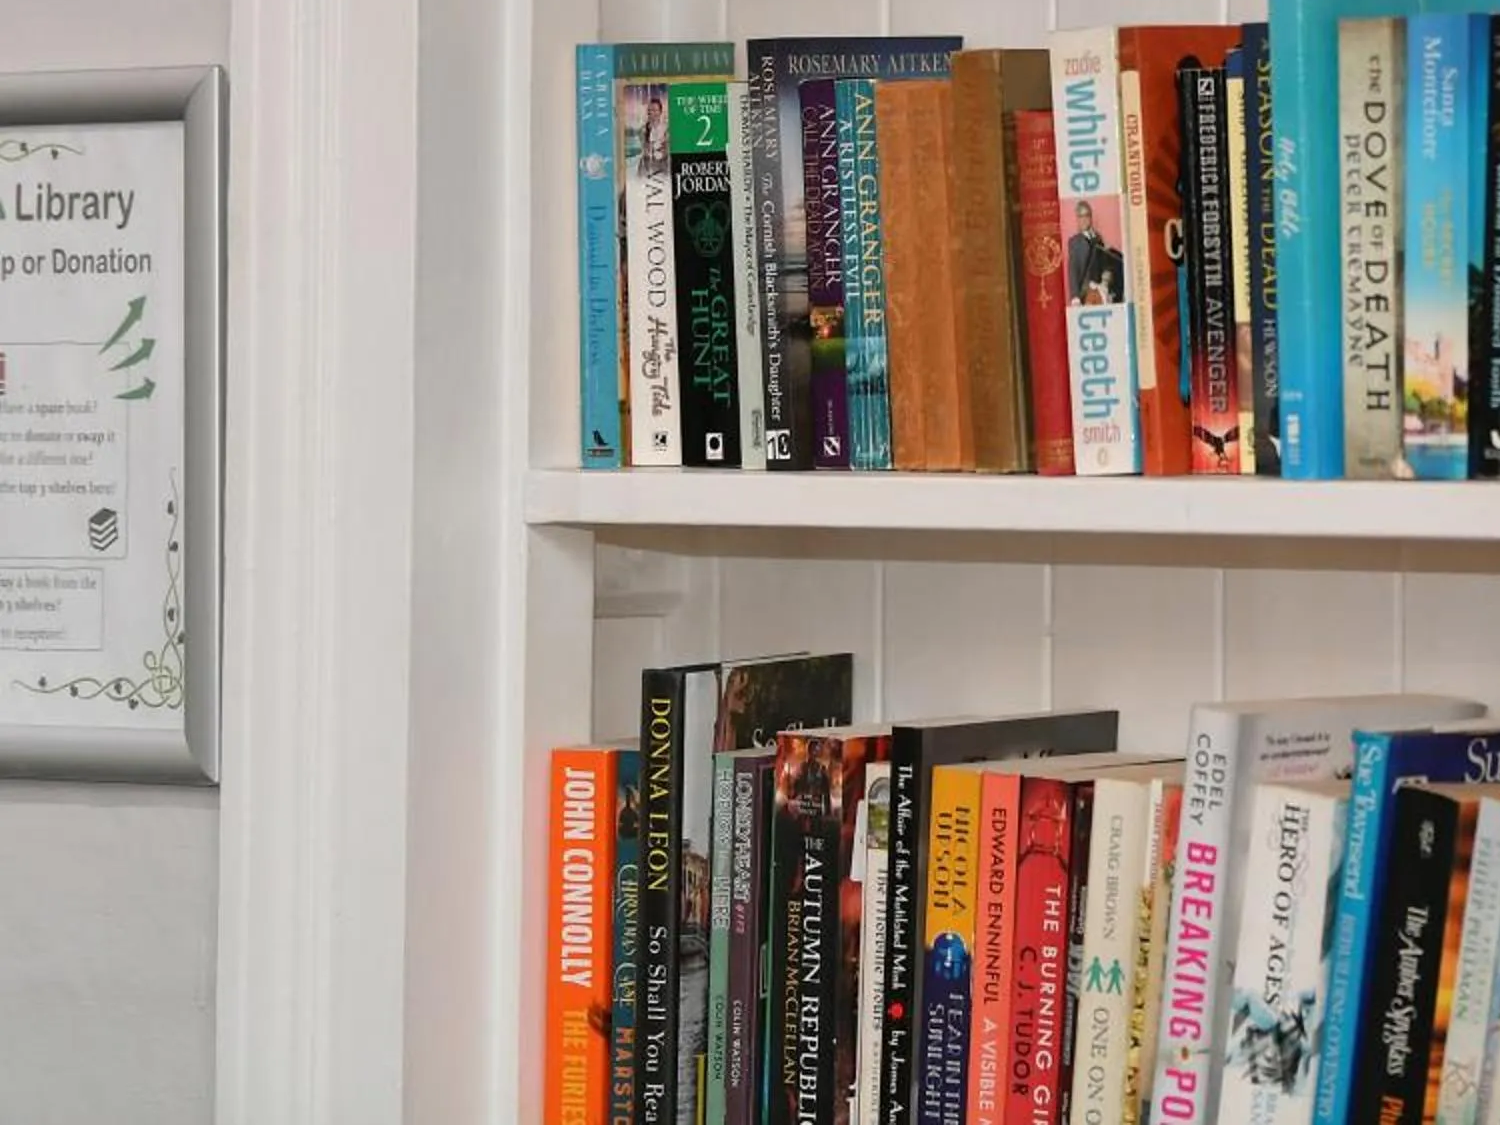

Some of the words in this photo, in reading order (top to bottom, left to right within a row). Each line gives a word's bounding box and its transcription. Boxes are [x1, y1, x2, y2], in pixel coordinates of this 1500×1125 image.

[787, 54, 882, 76] ROSEMARY
[1063, 53, 1103, 77] zadie
[760, 55, 780, 163] ROSEMARY
[839, 118, 853, 133] A
[855, 93, 876, 162] ANN
[1422, 35, 1443, 161] Montefiore
[1440, 67, 1460, 128] Santa
[694, 115, 714, 147] 2
[819, 103, 837, 159] ANN
[1064, 78, 1108, 194] white
[1125, 114, 1144, 207] CRANFORD
[1198, 104, 1219, 195] FREDERICK
[1363, 101, 1388, 218] DOVE
[645, 172, 666, 216] VAL
[675, 174, 730, 200] JORDAN
[680, 160, 730, 177] ROBERT
[840, 141, 859, 245] RESTLESS
[15, 182, 135, 230] Library
[760, 199, 778, 258] Cornish
[820, 164, 842, 289] GRANGER
[21, 254, 46, 275] or
[52, 247, 152, 275] Donation
[647, 220, 670, 308] WOOD
[857, 174, 886, 329] GRANGER
[1201, 199, 1223, 287] FORSYTH
[1260, 221, 1282, 311] DEAD
[763, 262, 784, 350] Blacksmith's
[843, 253, 862, 304] EVIL
[642, 315, 668, 380] Hungry
[663, 337, 677, 362] The
[691, 287, 711, 388] HUNT
[710, 294, 732, 411] GREAT
[1078, 309, 1121, 420] teeth
[1204, 297, 1227, 415] AVENGER
[1363, 260, 1392, 412] DEATH
[650, 377, 672, 418] Tide
[765, 353, 785, 422] Daughter
[1081, 423, 1122, 447] smith
[648, 696, 672, 801] DONNA
[897, 764, 913, 790] The
[1356, 742, 1383, 786] Sue
[562, 765, 597, 841] JOHN
[1189, 733, 1212, 827] COFFEY
[1208, 753, 1228, 813] EDEL
[804, 836, 825, 850] THE
[896, 795, 913, 836] Affair
[1107, 815, 1124, 871] CRAIG
[1276, 803, 1303, 884] HERO
[1343, 789, 1378, 901] Townsend
[646, 811, 670, 892] LEON
[895, 839, 911, 856] of
[895, 860, 911, 880] the
[988, 807, 1008, 895] EDWARD
[560, 847, 596, 988] CONNOLLY
[786, 900, 801, 962] BRIAN
[801, 851, 824, 984] AUTUMN
[1041, 883, 1062, 932] THE
[1271, 891, 1296, 931] OF
[1404, 905, 1431, 938] The
[647, 924, 668, 954] So
[982, 901, 1004, 1006] ENNINFUL
[1018, 945, 1037, 973] C.
[1168, 841, 1219, 1043] BREAKING
[1396, 930, 1426, 999] Amber
[645, 962, 668, 1021] Shall
[891, 955, 908, 991] Mink
[1016, 979, 1035, 1000] J.
[1262, 935, 1288, 1007] AGES
[563, 1008, 590, 1049] THE
[732, 999, 743, 1034] COLIN
[783, 967, 800, 1085] McCLELLAN
[888, 1030, 907, 1047] by
[981, 1017, 997, 1033] A
[1035, 945, 1060, 1071] BURNING
[1089, 1007, 1111, 1059] ONE
[644, 1031, 666, 1073] You
[731, 1037, 742, 1088] WATSON
[889, 1051, 906, 1095] James
[924, 1001, 946, 1118] SUNLIGHT
[979, 1040, 997, 1113] VISIBLE
[1011, 1007, 1034, 1097] TUDOR
[1087, 1064, 1107, 1104] ON
